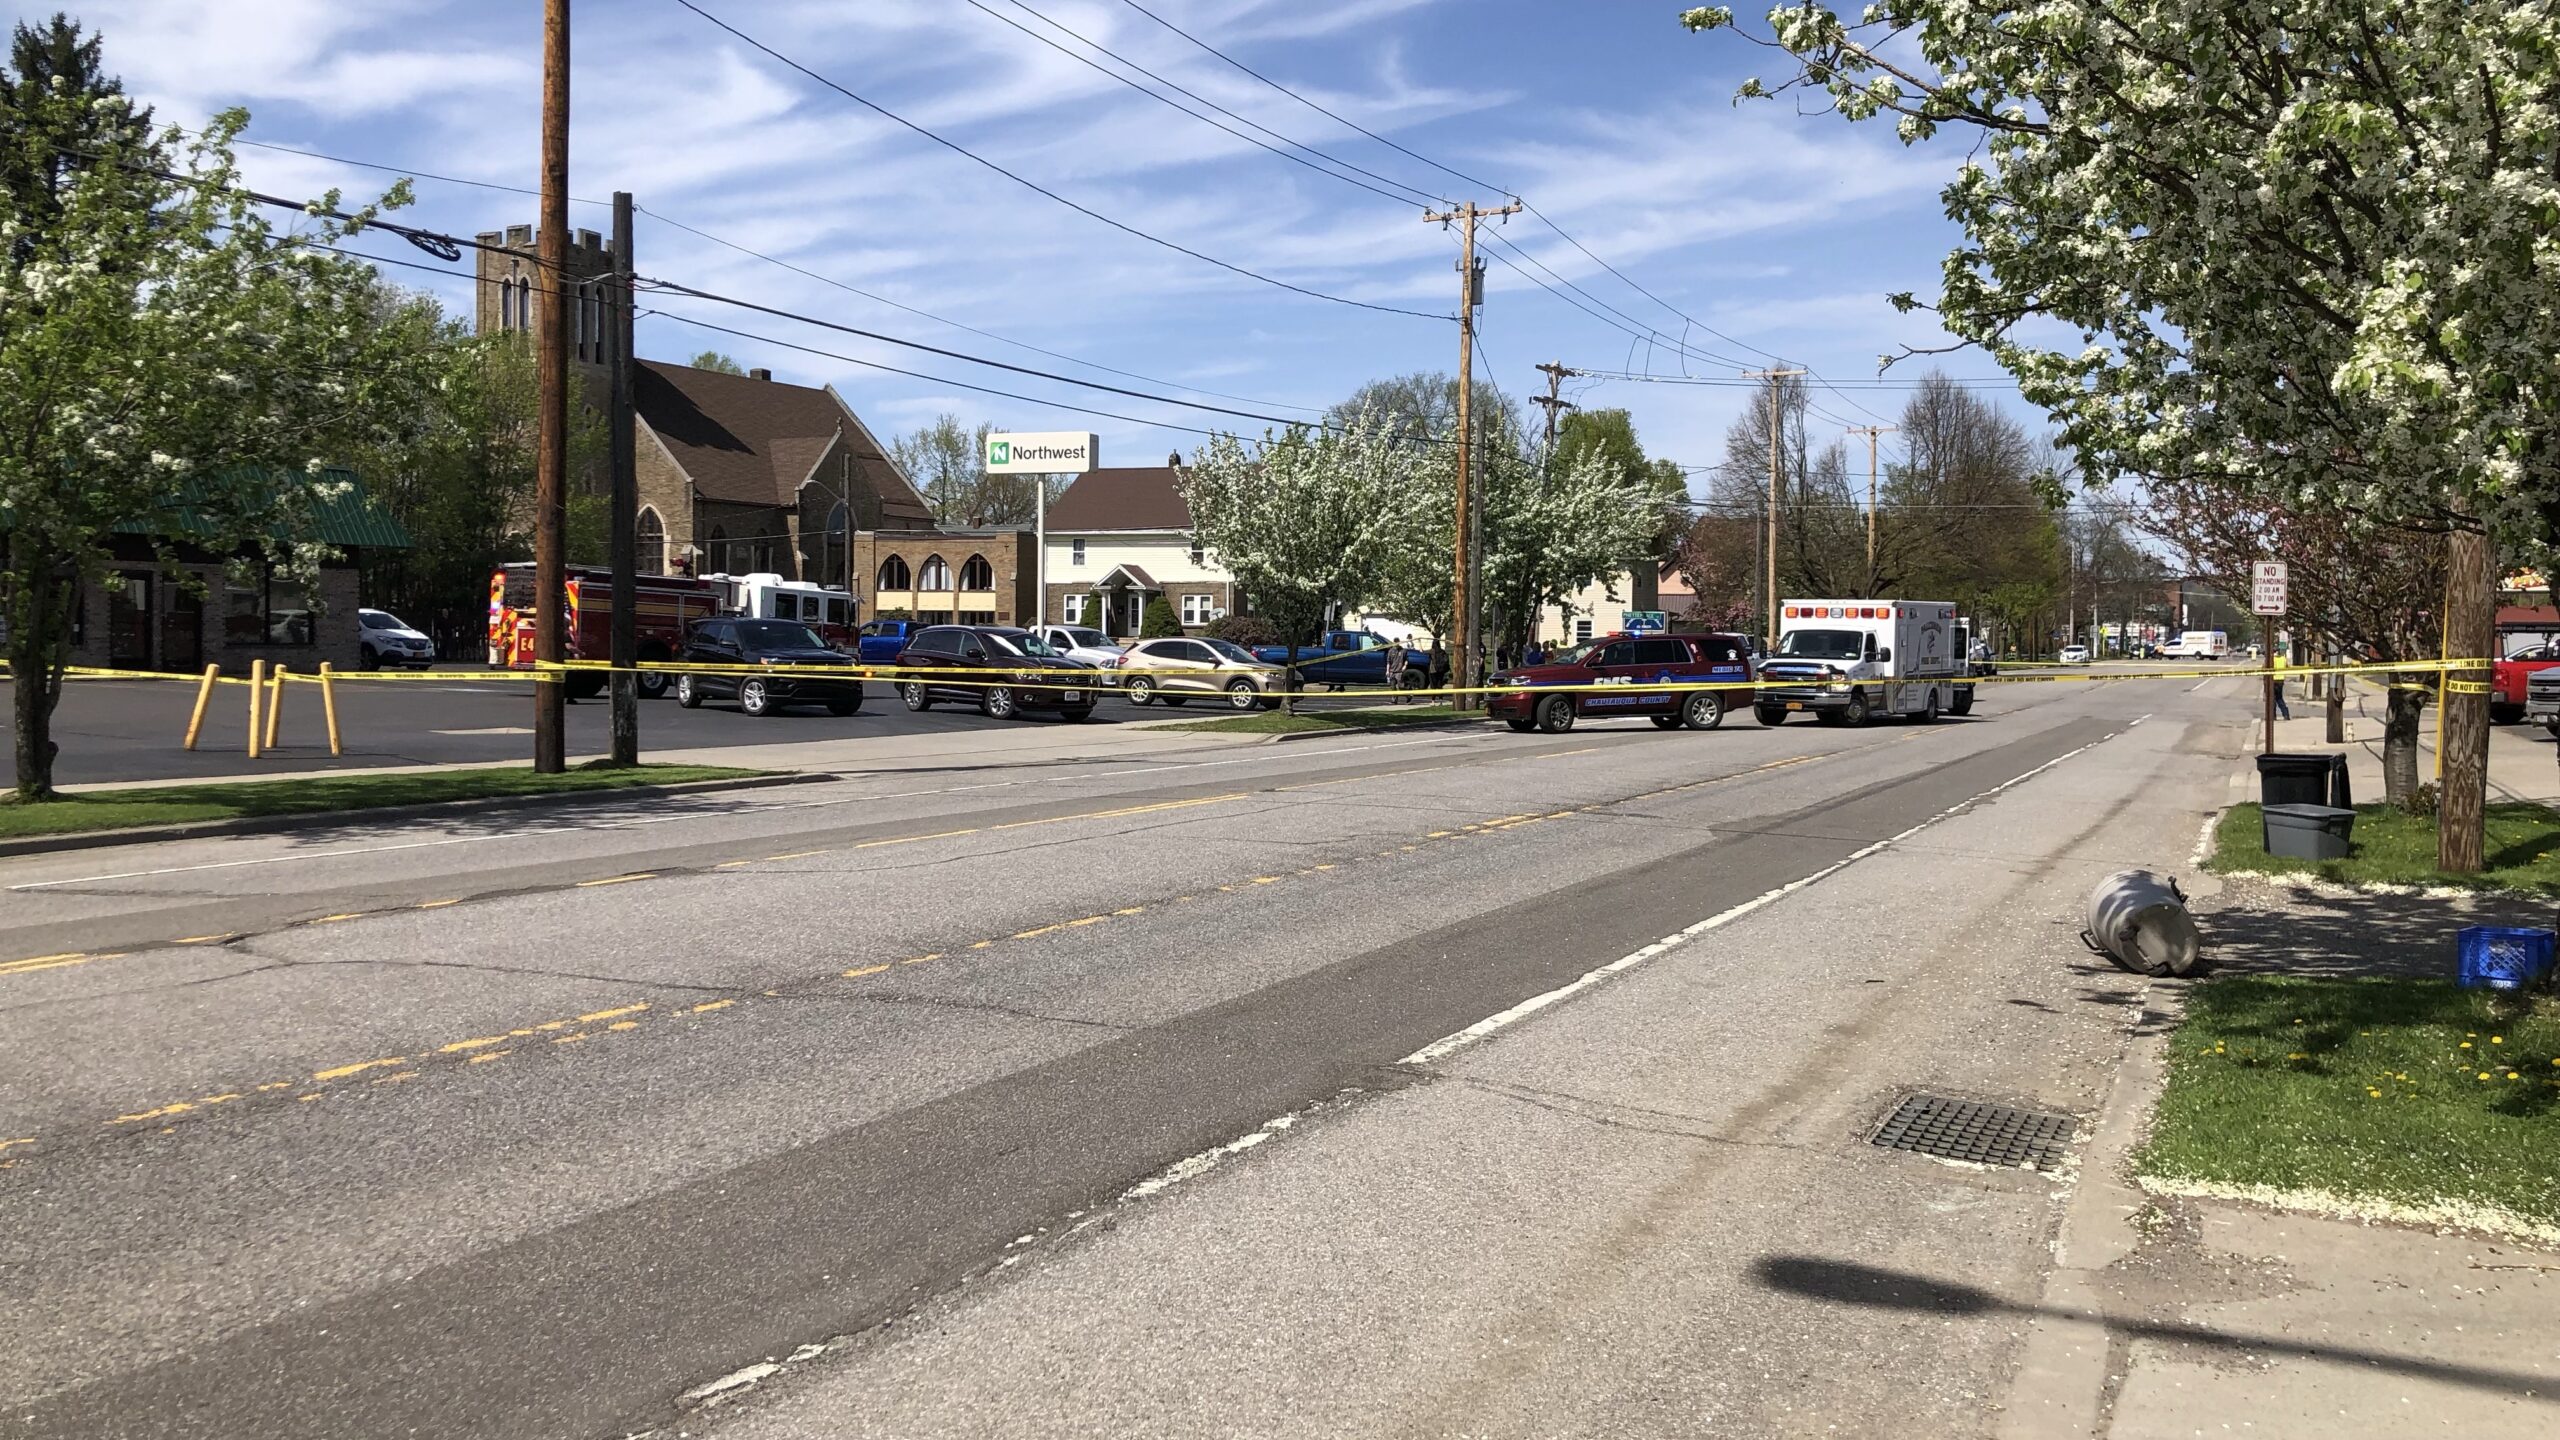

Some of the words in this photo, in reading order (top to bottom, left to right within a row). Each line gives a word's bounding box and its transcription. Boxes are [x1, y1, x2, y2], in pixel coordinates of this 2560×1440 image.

[1012, 445, 1085, 460] Northwest
[2264, 566, 2276, 576] NO
[2272, 586, 2280, 594] AM
[2276, 595, 2284, 603] AM
[521, 637, 534, 651] E4
[2476, 660, 2485, 668] DO
[1594, 676, 1633, 685] EMS
[2450, 682, 2459, 690] DO
[2459, 683, 2473, 691] NOT
[1585, 697, 1637, 706] CHAUTAUQUA
[1639, 696, 1671, 704] COUNTY
